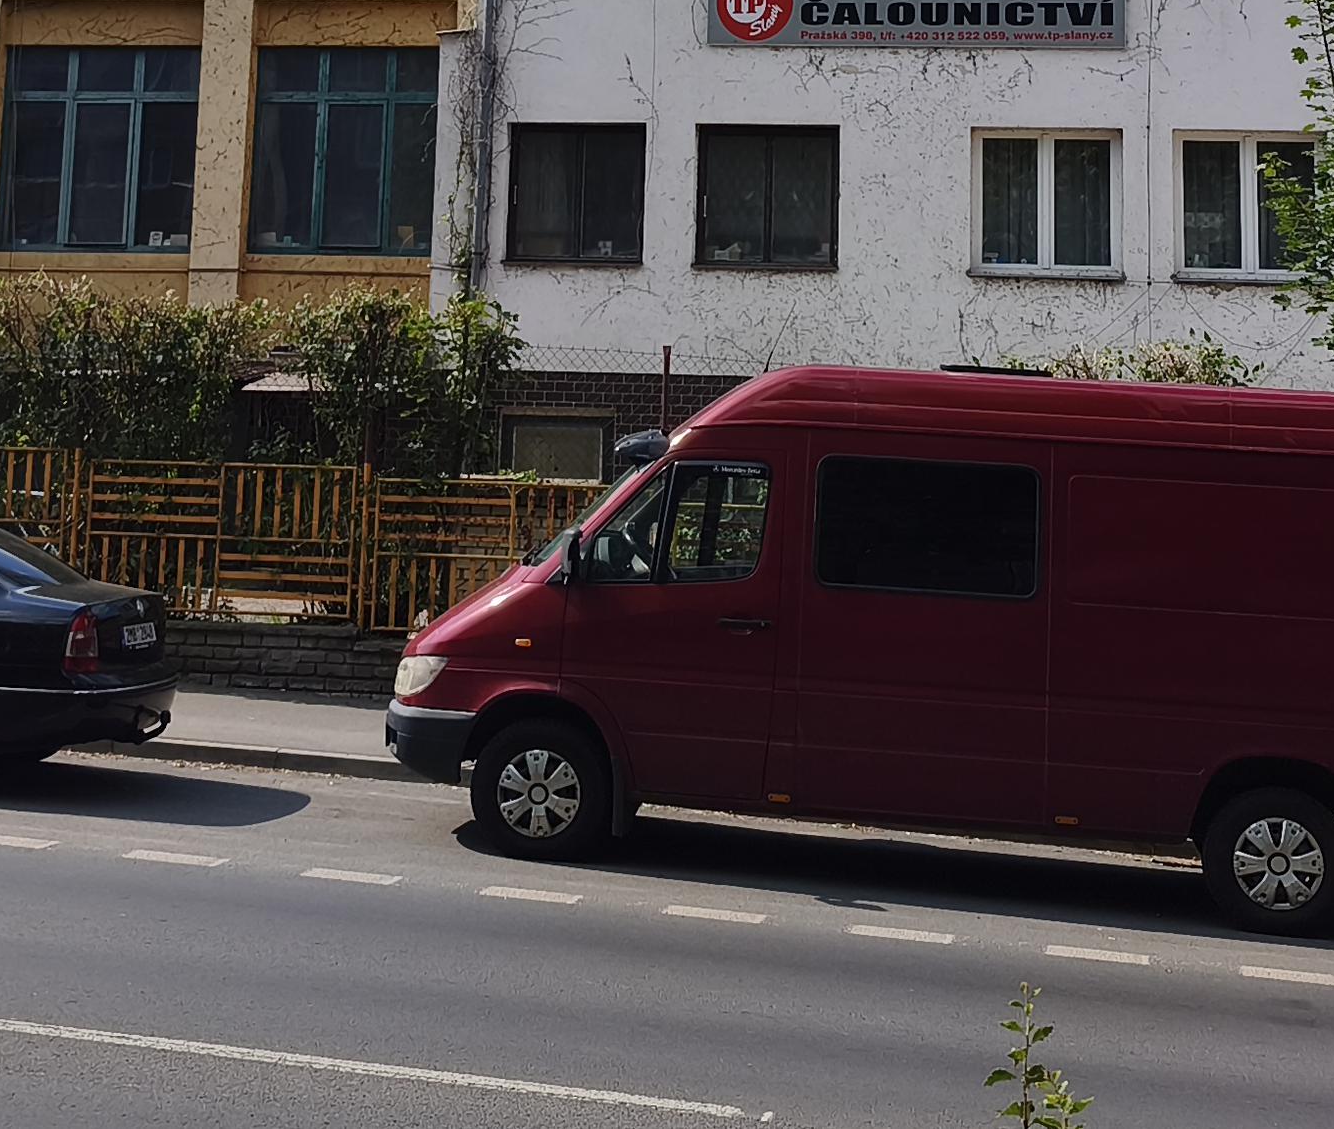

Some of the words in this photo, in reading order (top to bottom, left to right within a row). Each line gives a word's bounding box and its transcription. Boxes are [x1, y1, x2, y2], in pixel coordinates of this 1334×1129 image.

[749, 3, 783, 36] Slaný
[800, 30, 847, 40] Pražská
[900, 31, 928, 40] +420
[932, 31, 954, 40] 312
[958, 31, 980, 40] 522
[983, 31, 1009, 42] 059,
[1013, 30, 1114, 42] www.tp-slany.cz
